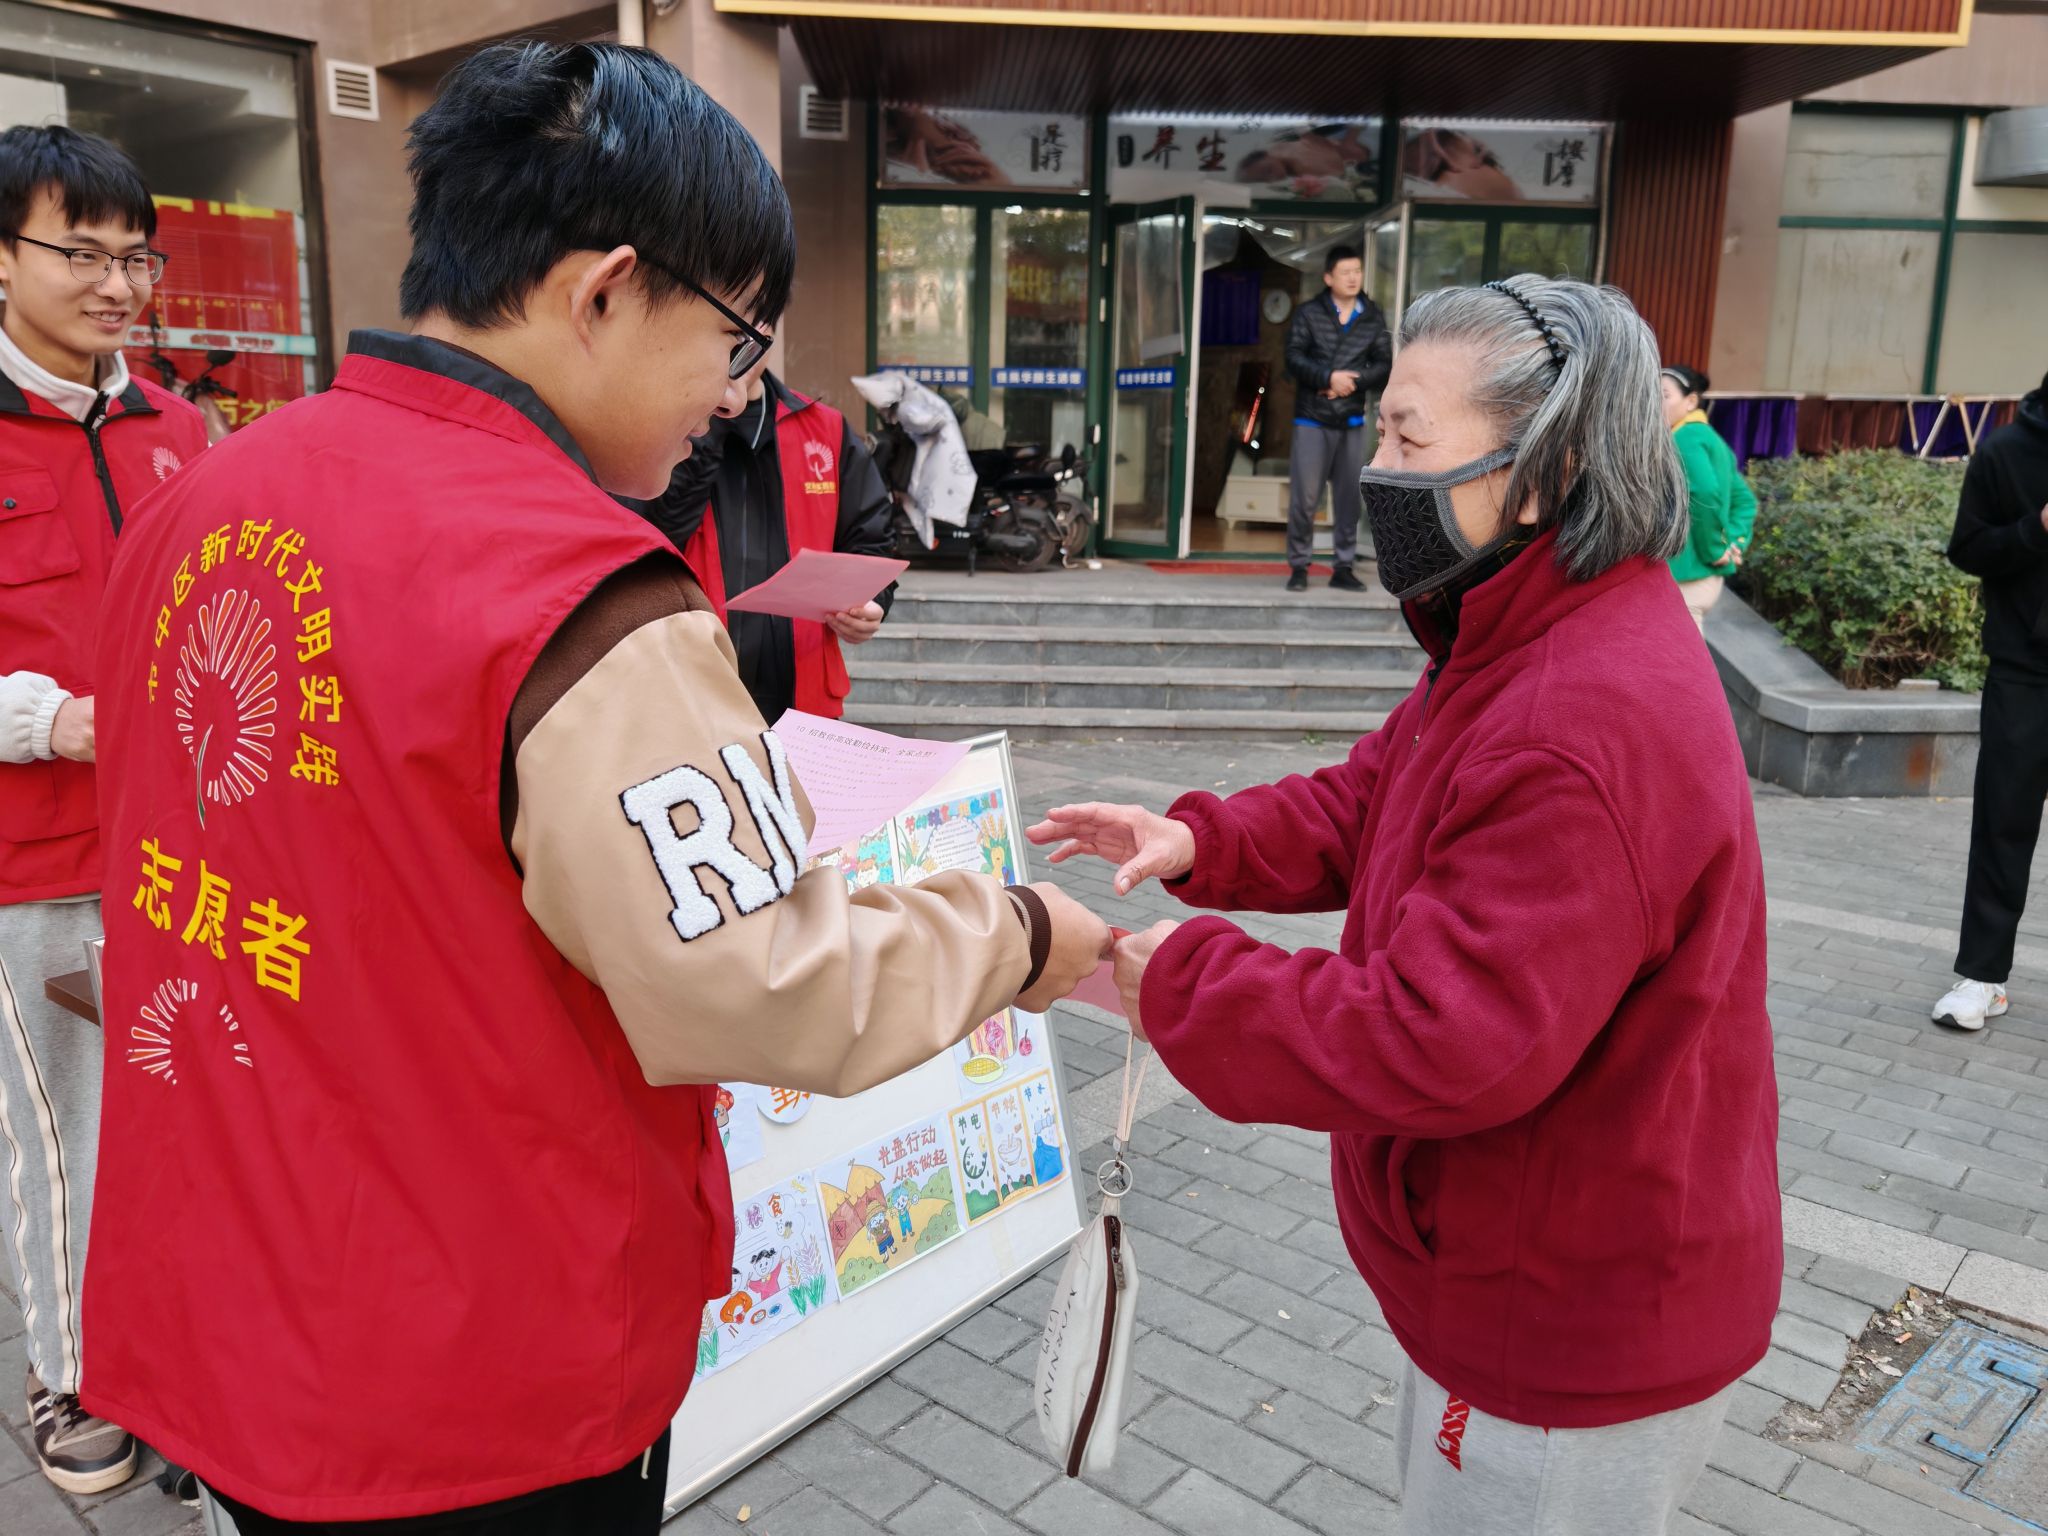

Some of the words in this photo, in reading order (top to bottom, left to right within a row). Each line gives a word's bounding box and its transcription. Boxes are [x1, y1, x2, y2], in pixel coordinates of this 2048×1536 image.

[1142, 125, 1227, 171] 养生
[132, 837, 311, 1002] 志愿者
[878, 1124, 937, 1168] 光盘行动
[893, 1148, 948, 1184] 从我做起
